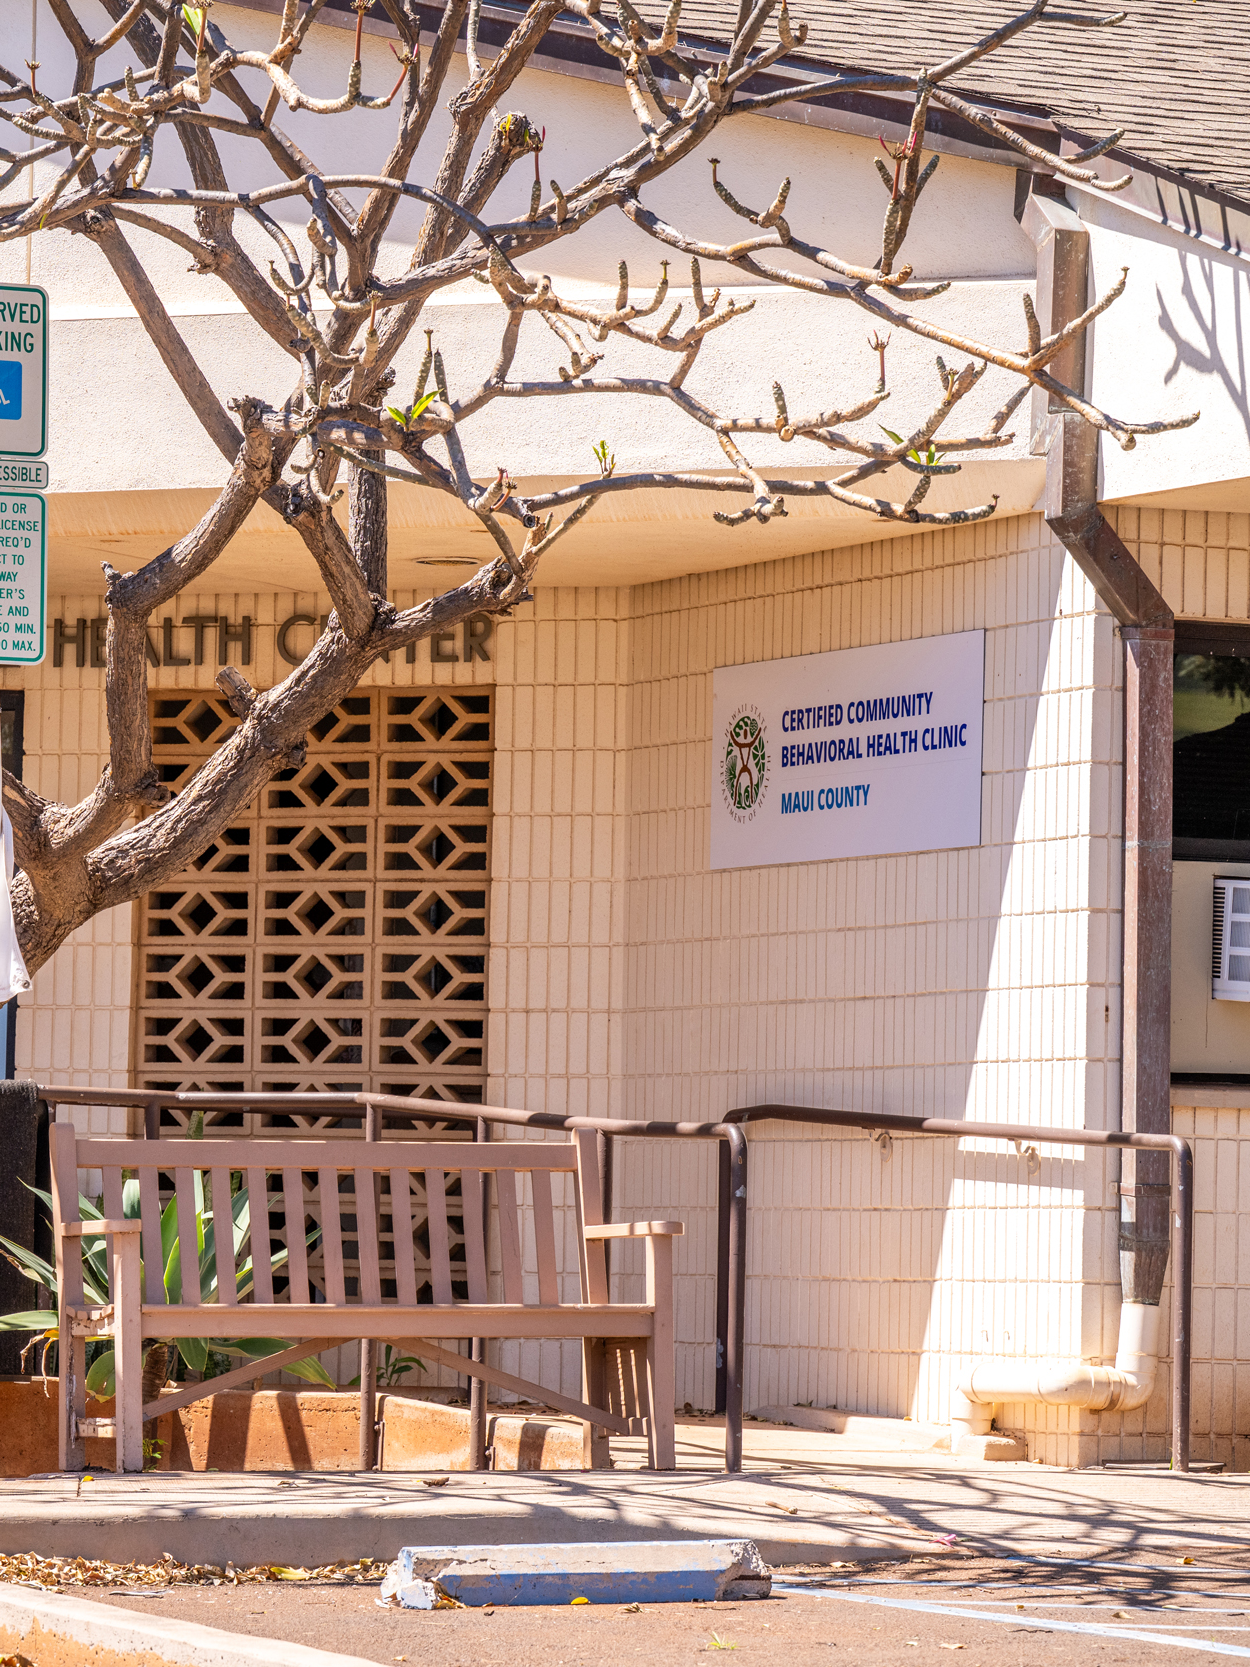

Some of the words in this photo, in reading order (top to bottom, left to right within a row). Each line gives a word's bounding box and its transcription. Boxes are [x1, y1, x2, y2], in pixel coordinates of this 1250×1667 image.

[12, 503, 27, 514] OR
[11, 554, 25, 566] TO
[7, 605, 29, 617] AND
[14, 622, 36, 635] MIN.
[12, 639, 36, 652] MAX.
[781, 703, 844, 733] CERTIFIED
[846, 691, 934, 725] COMMUNITY
[781, 737, 863, 768] BEHAVIORAL
[866, 729, 918, 758] HEALTH
[921, 723, 968, 752] CLINIC
[780, 790, 815, 815] MAUI
[817, 784, 871, 811] COUNTY
